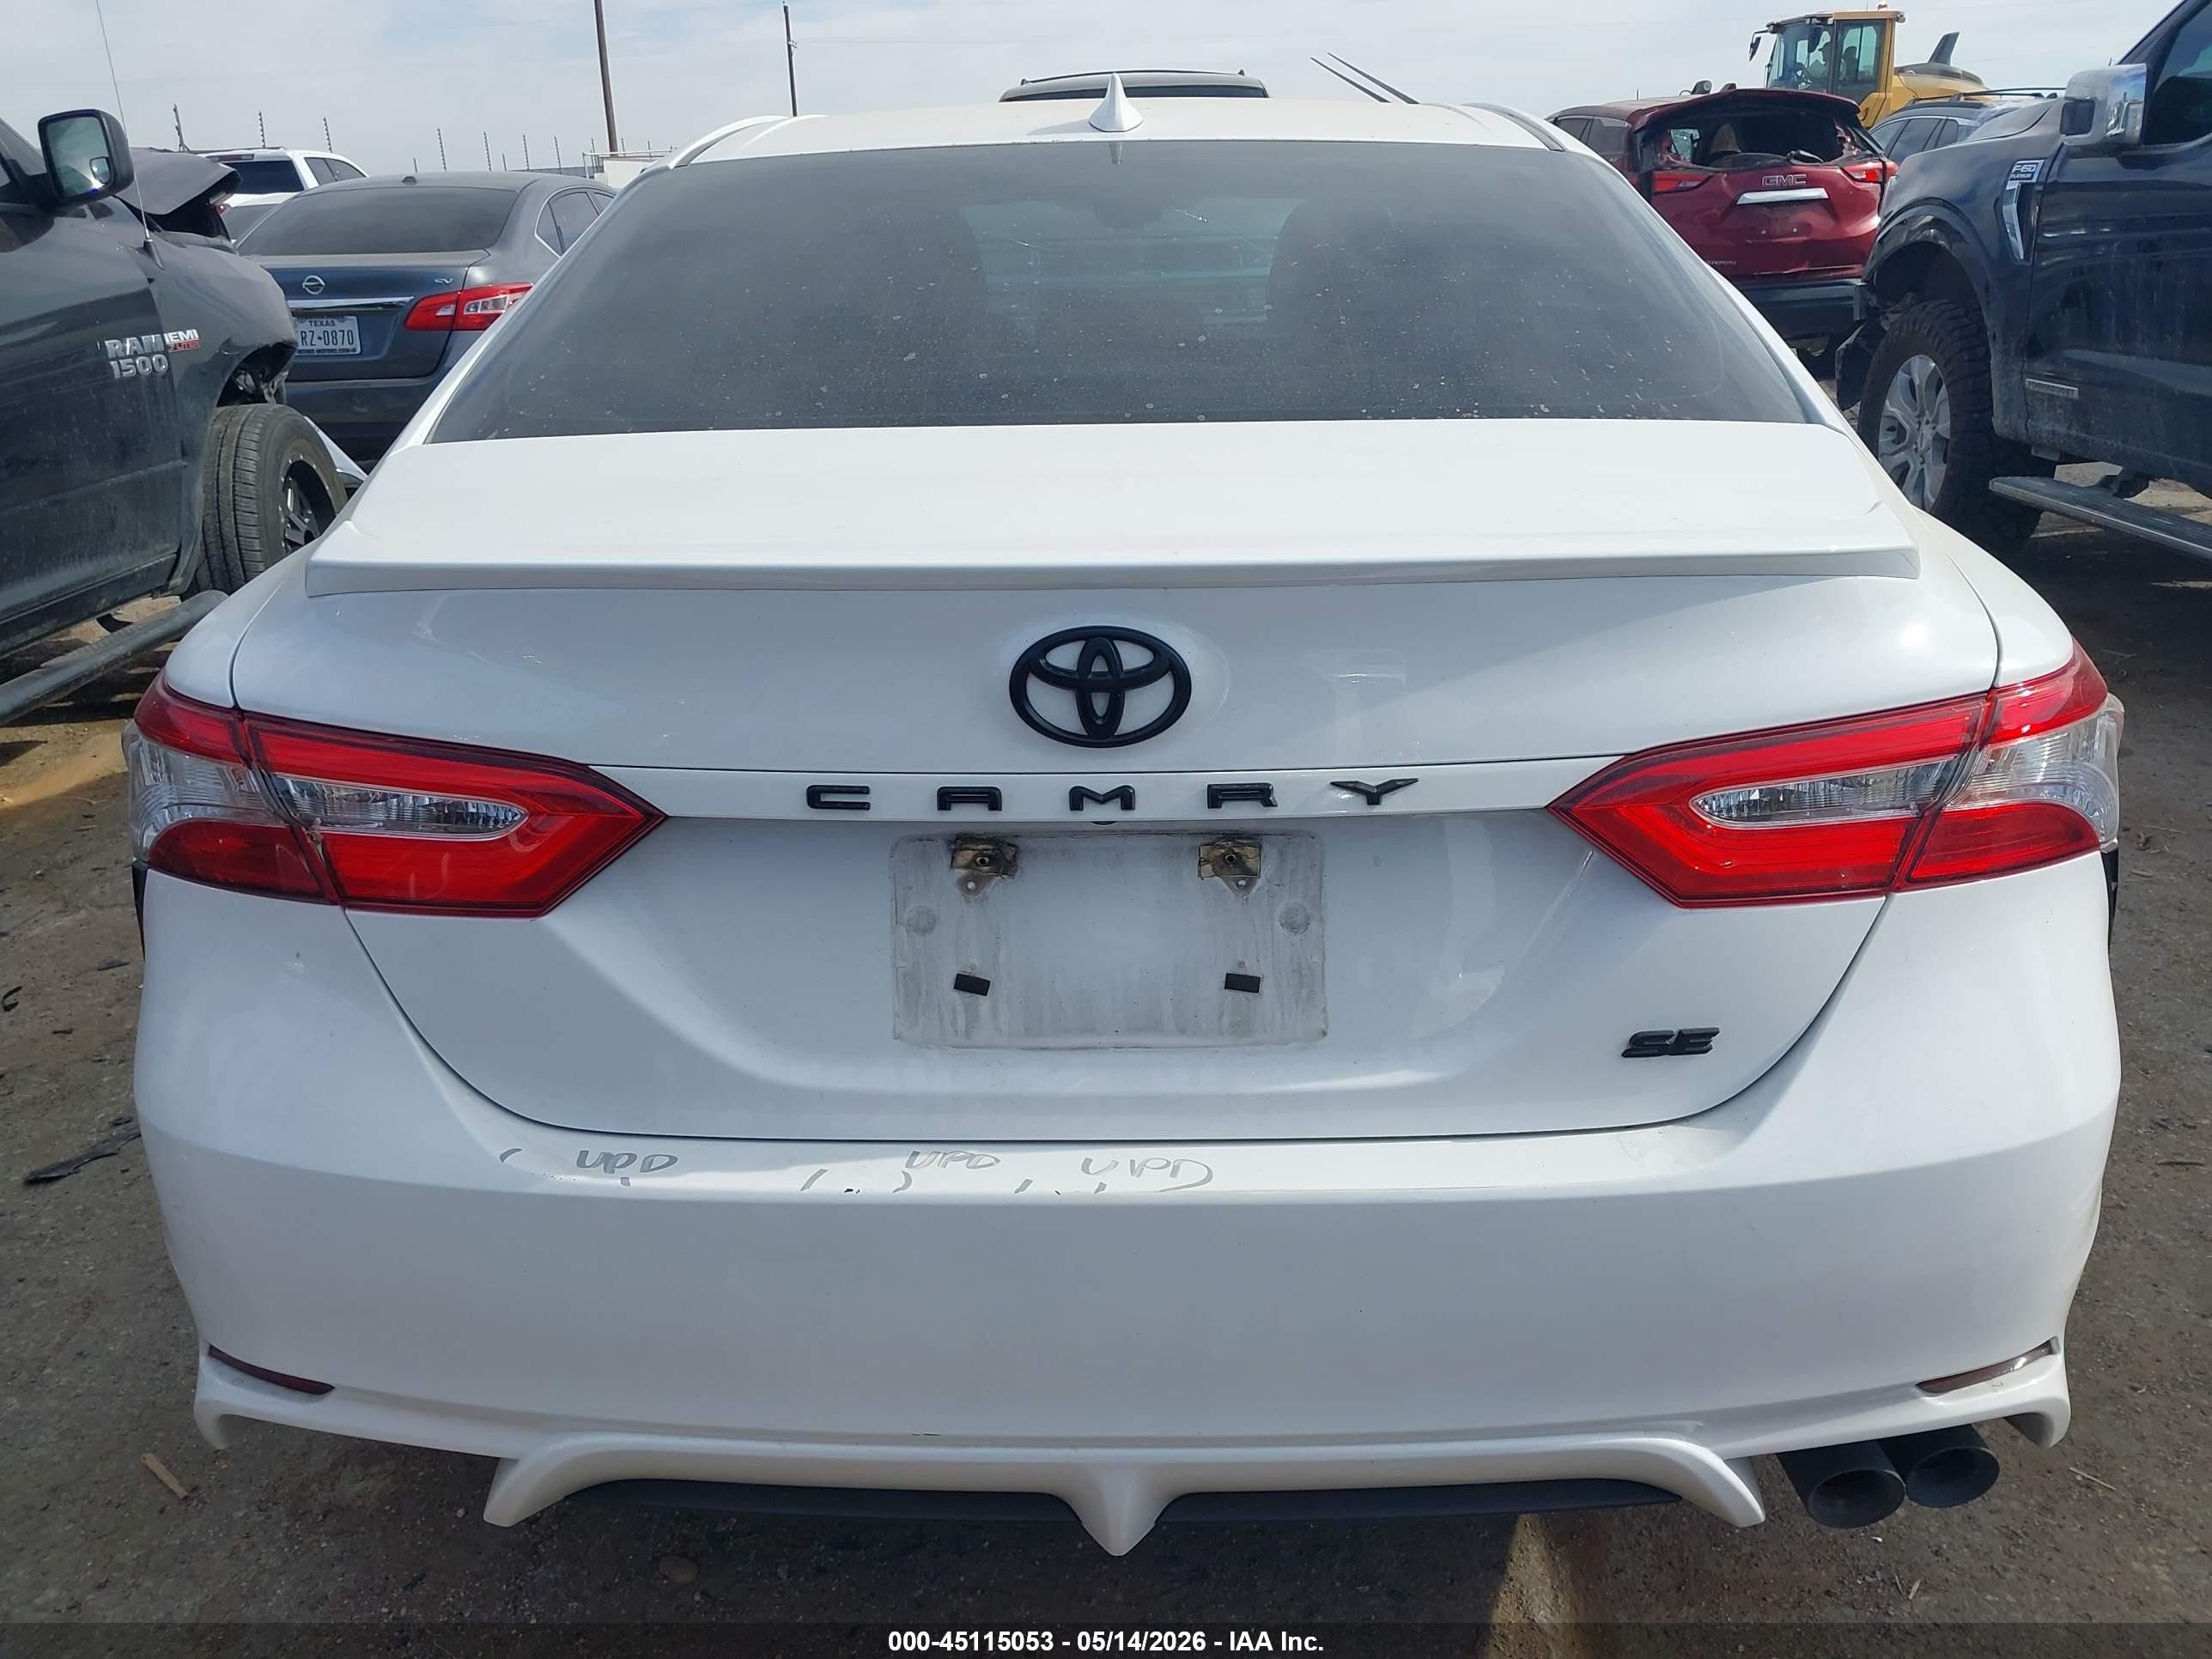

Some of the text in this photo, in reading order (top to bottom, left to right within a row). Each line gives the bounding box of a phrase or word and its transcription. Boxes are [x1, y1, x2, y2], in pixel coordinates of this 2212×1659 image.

[1762, 173, 1807, 186] GMC
[105, 334, 164, 358] RAM
[301, 329, 354, 346] RZ-0870
[110, 354, 168, 379] 1500
[805, 777, 1420, 811] CAMRY
[1621, 1027, 1720, 1058] SE
